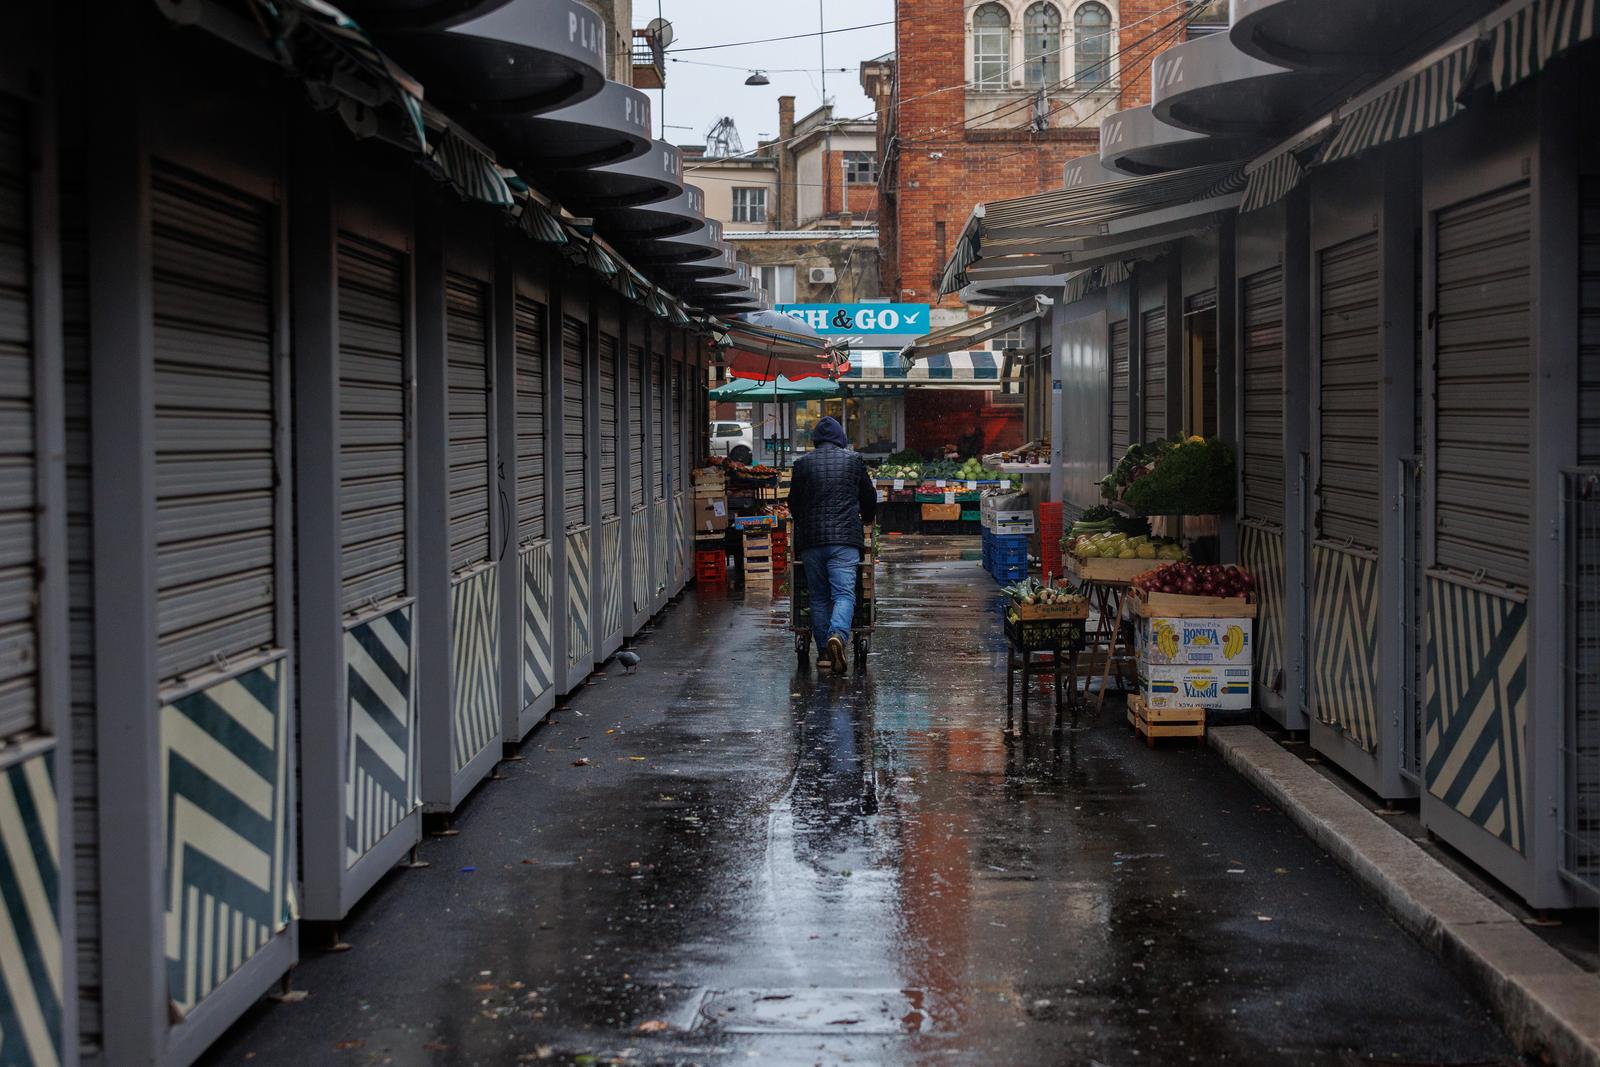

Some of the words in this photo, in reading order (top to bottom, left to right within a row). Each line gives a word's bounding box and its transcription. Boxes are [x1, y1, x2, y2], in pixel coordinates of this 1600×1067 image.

[832, 309, 853, 329] &
[856, 310, 900, 330] GO
[1183, 628, 1219, 645] BONITA
[1184, 682, 1218, 698] BONITA
